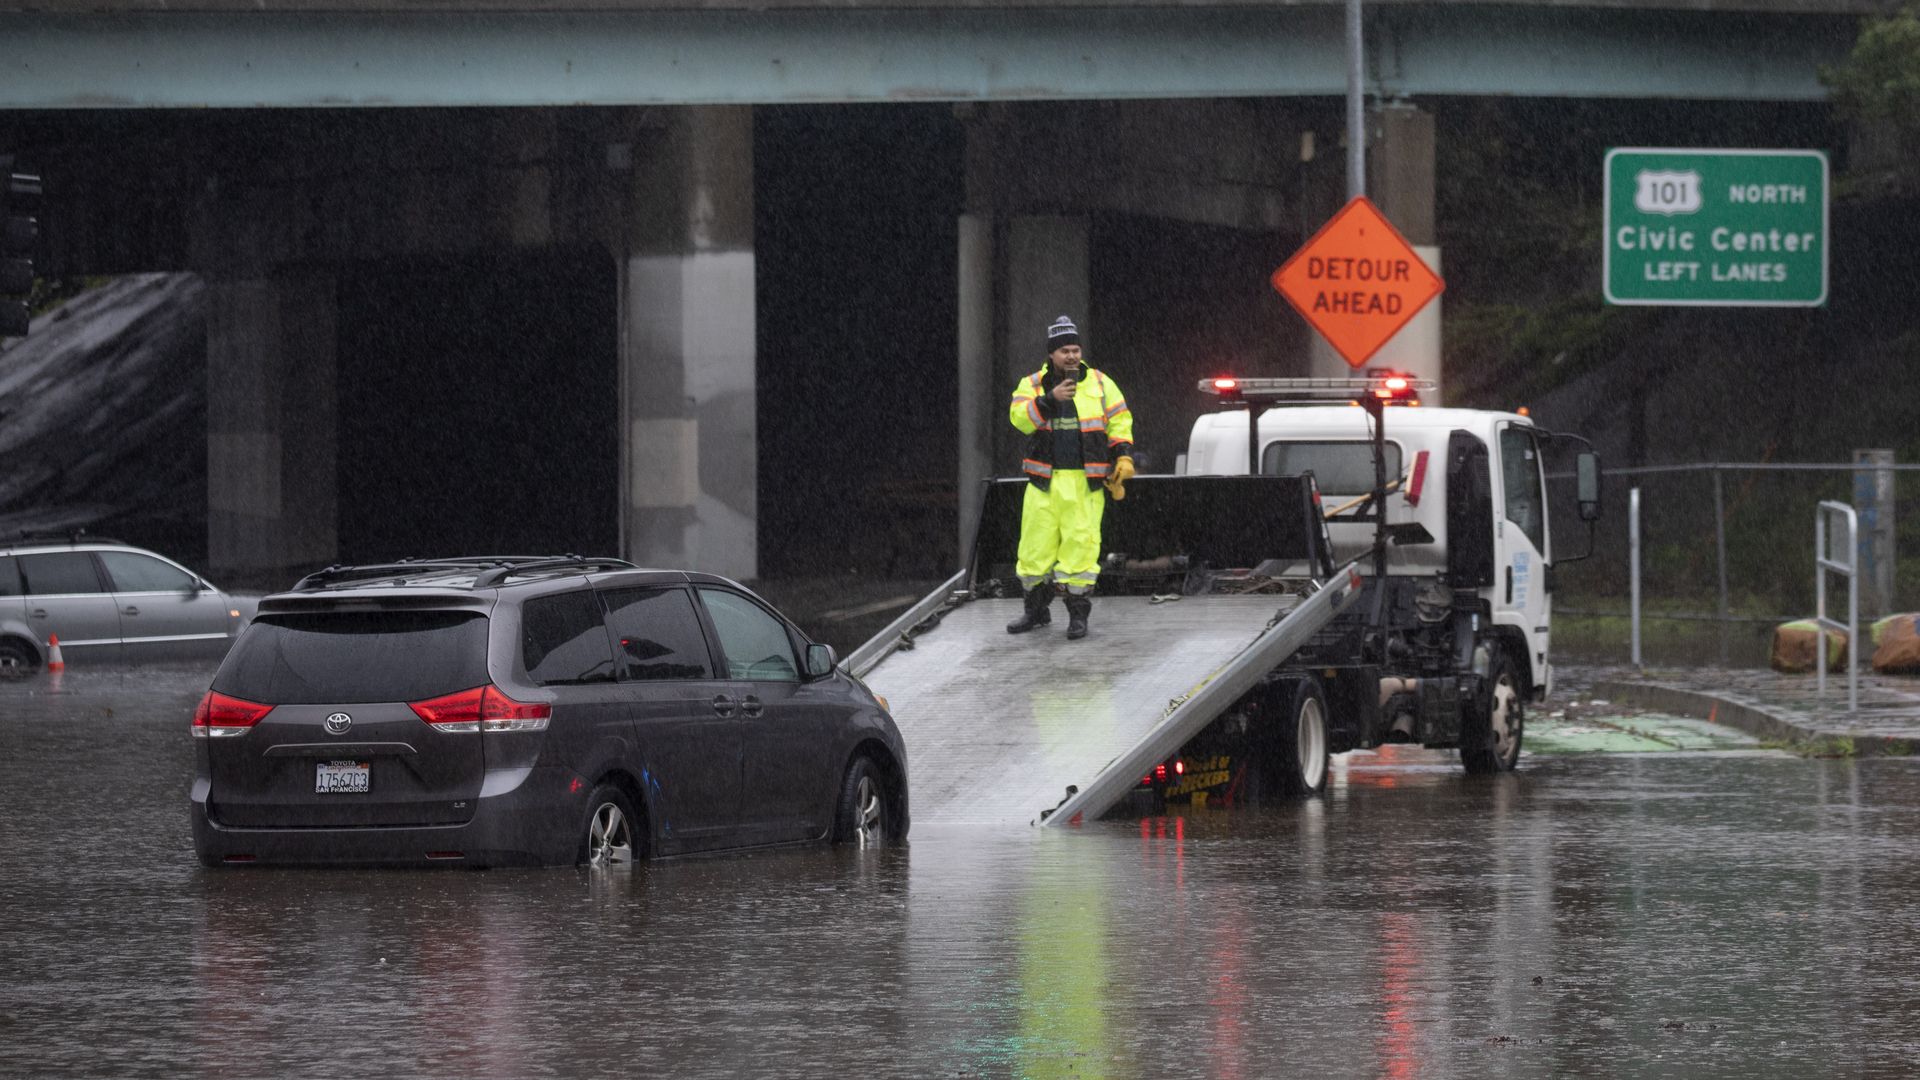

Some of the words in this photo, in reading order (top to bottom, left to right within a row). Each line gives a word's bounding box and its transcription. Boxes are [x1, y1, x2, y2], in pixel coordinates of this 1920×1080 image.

[1651, 181, 1687, 204] 101
[1729, 184, 1806, 203] NORTH
[1617, 226, 1694, 250] Civic
[1711, 227, 1815, 252] Center
[1308, 257, 1410, 282] DETOUR
[1644, 262, 1700, 281] LEFT
[1711, 263, 1787, 282] LANES
[1312, 291, 1403, 315] AHEAD
